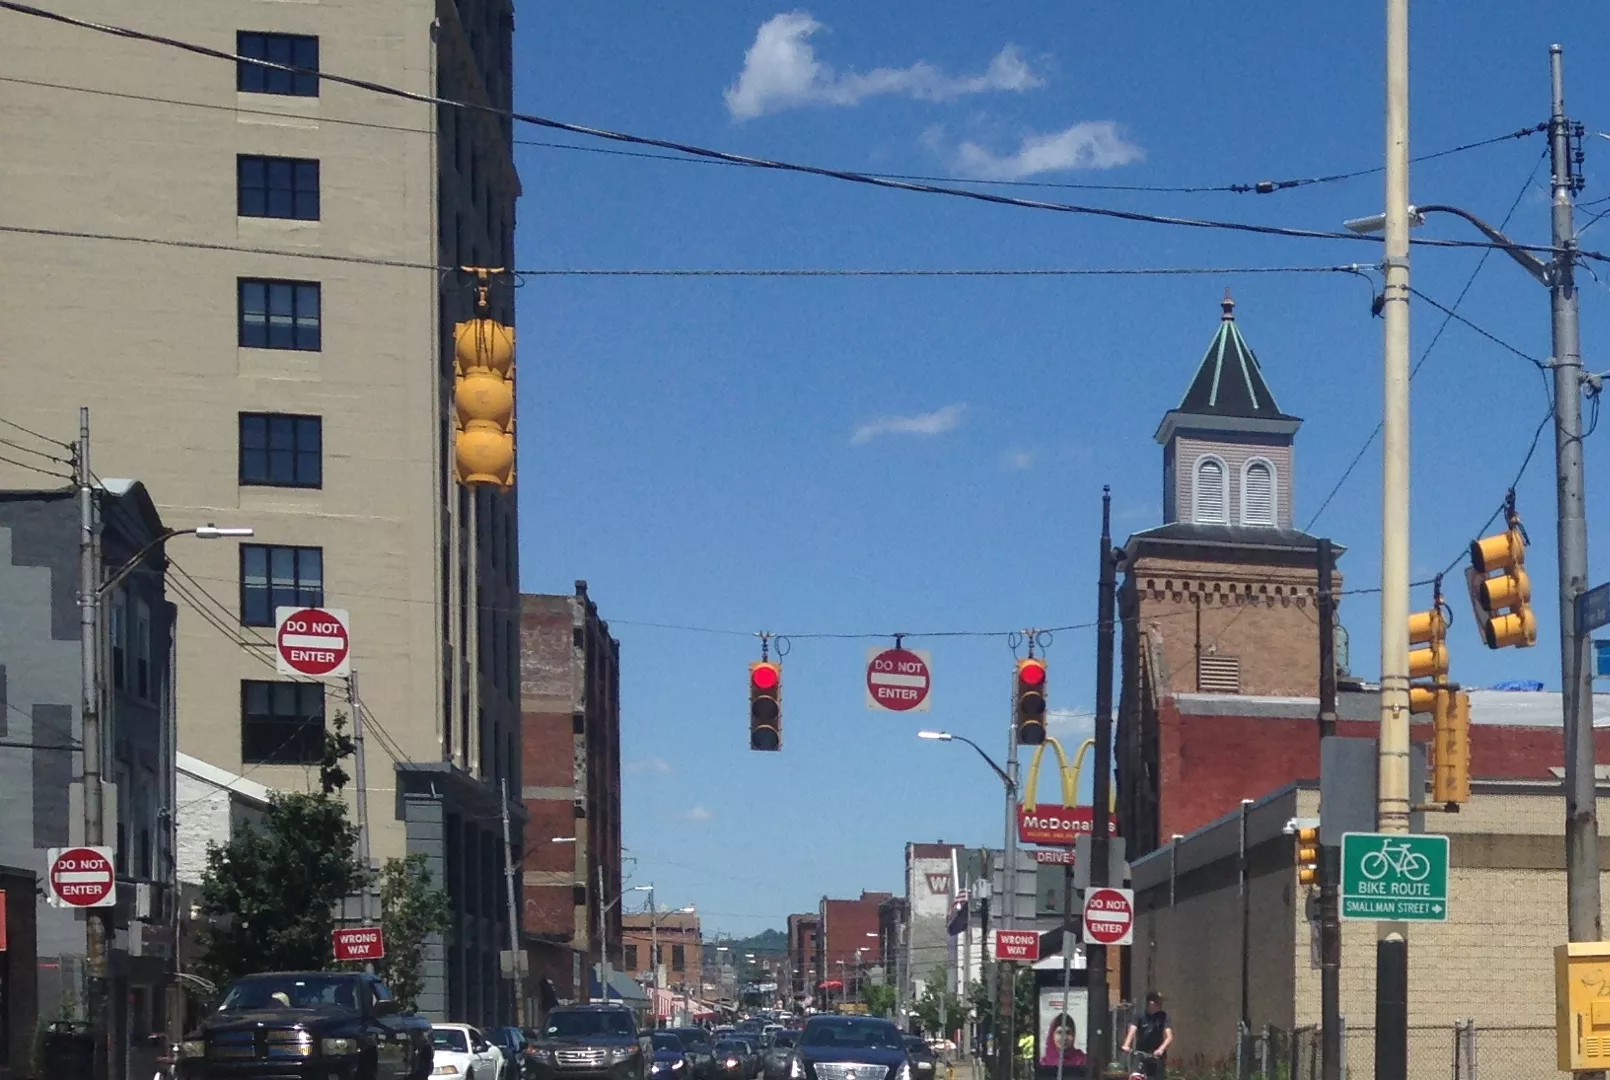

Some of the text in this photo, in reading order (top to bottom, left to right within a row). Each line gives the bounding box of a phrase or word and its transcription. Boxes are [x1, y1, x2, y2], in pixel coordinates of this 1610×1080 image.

[286, 620, 340, 634] DO NOT
[290, 650, 336, 663] ENTER
[875, 660, 922, 673] DO NOT
[878, 687, 918, 700] ENTER
[58, 859, 105, 869] DO NOT
[62, 885, 103, 895] ENTER
[1358, 881, 1430, 896] BIKE ROUTE
[1090, 899, 1126, 909] DO NOT
[1346, 901, 1430, 914] SMALLMAN STREET
[1092, 923, 1122, 933] ENTER
[340, 933, 377, 944] WRONG
[1000, 935, 1035, 945] WRONG
[347, 945, 370, 954] WAY
[1007, 946, 1028, 955] WAY
